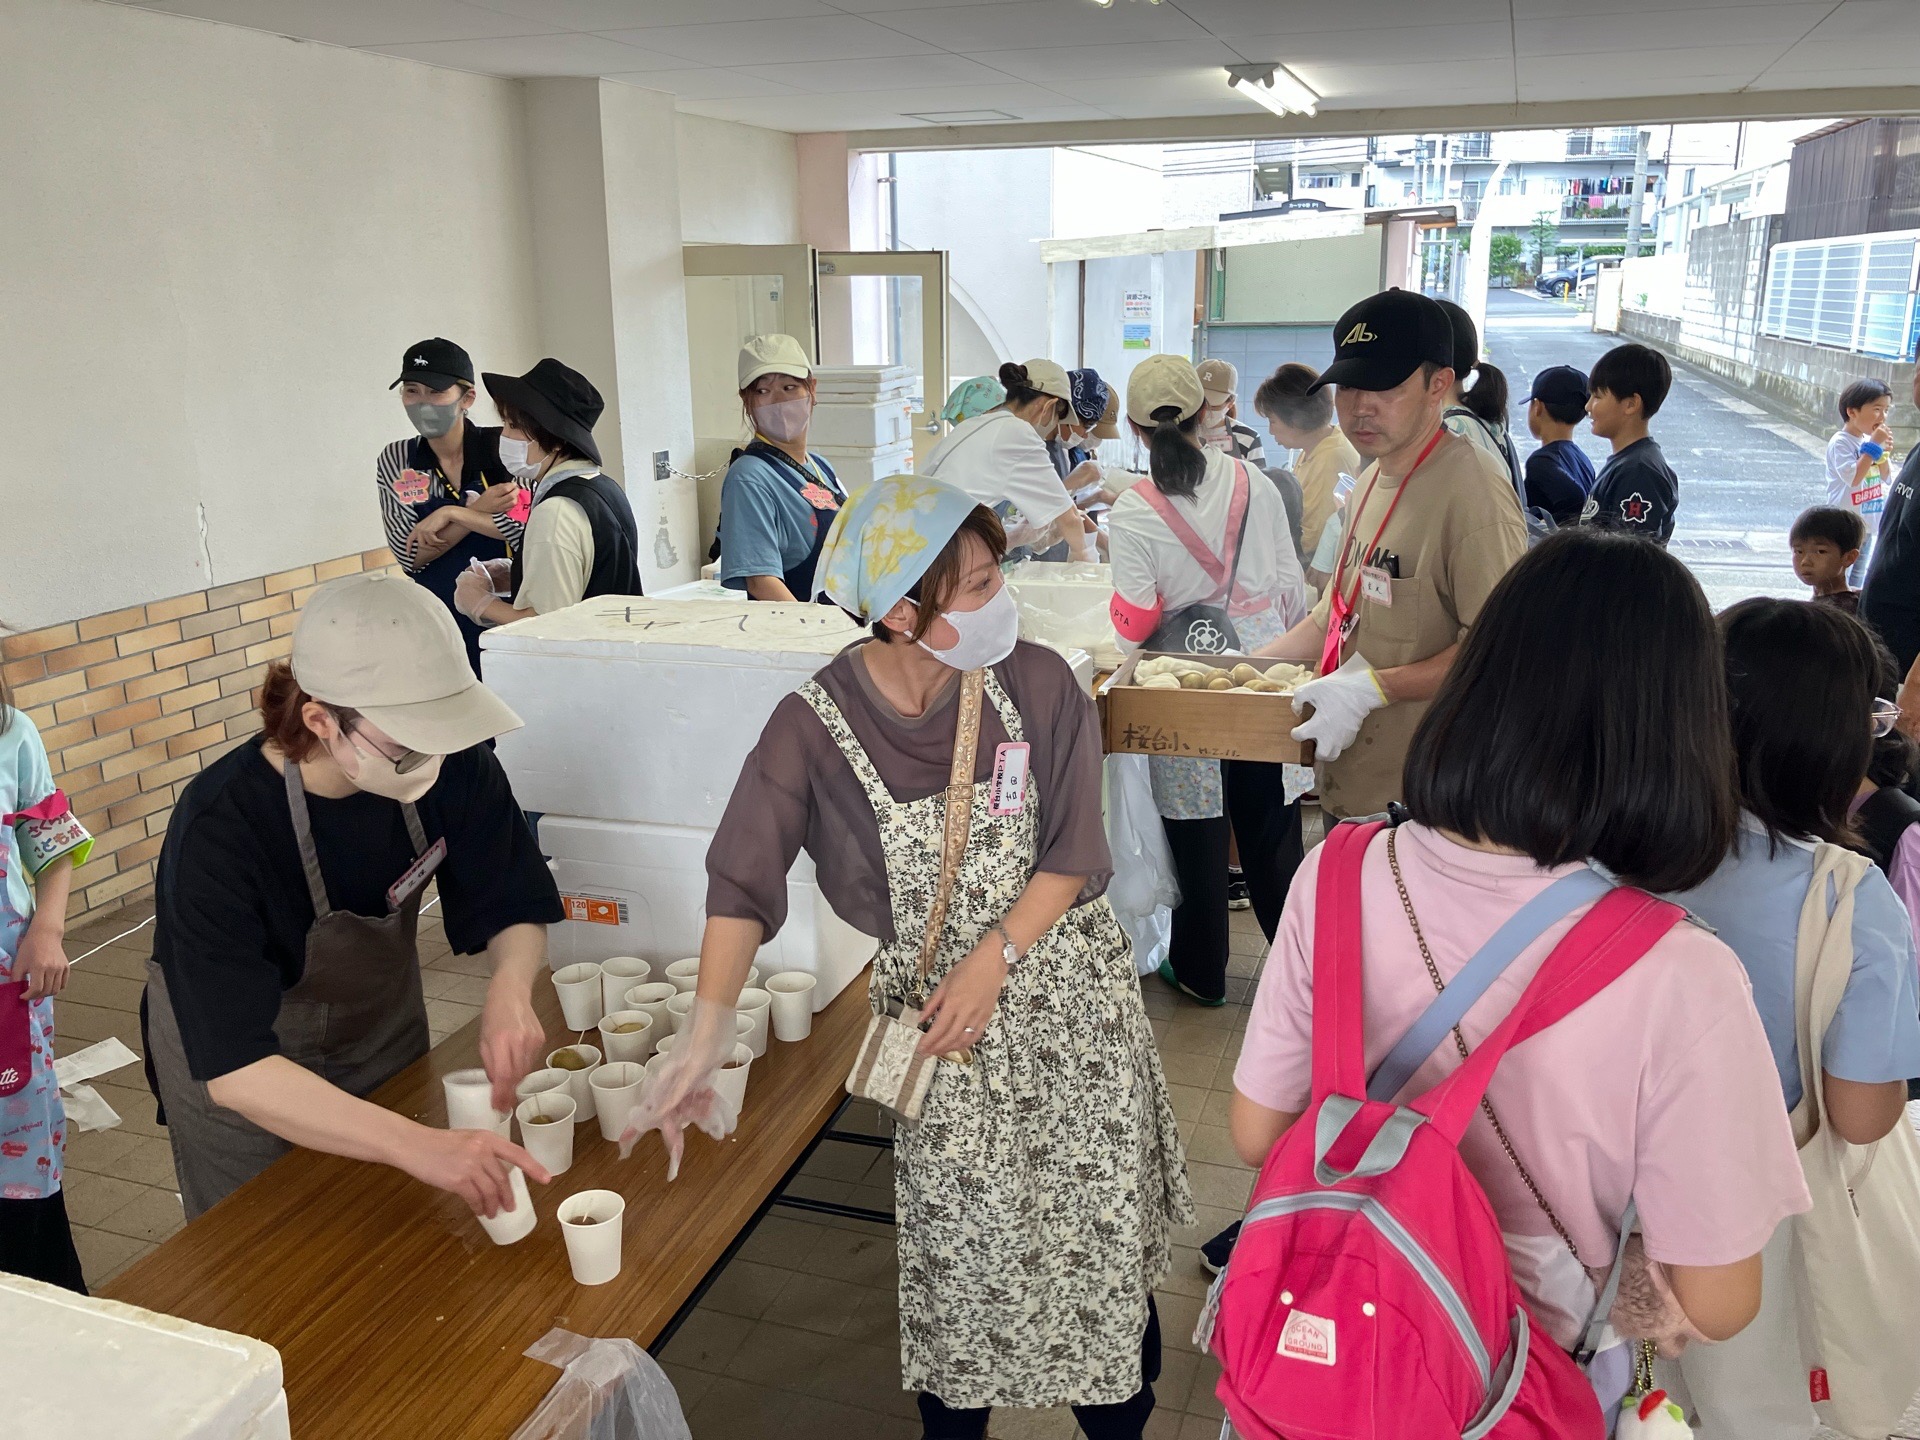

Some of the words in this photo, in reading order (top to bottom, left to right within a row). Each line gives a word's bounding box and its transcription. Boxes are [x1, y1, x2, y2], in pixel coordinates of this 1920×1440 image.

[1203, 372, 1213, 381] R
[1114, 609, 1129, 626] PTA
[1121, 722, 1190, 752] 桜台小
[572, 900, 586, 908] 120
[1291, 1325, 1319, 1339] OCEAN
[1287, 1337, 1323, 1351] GROUND
